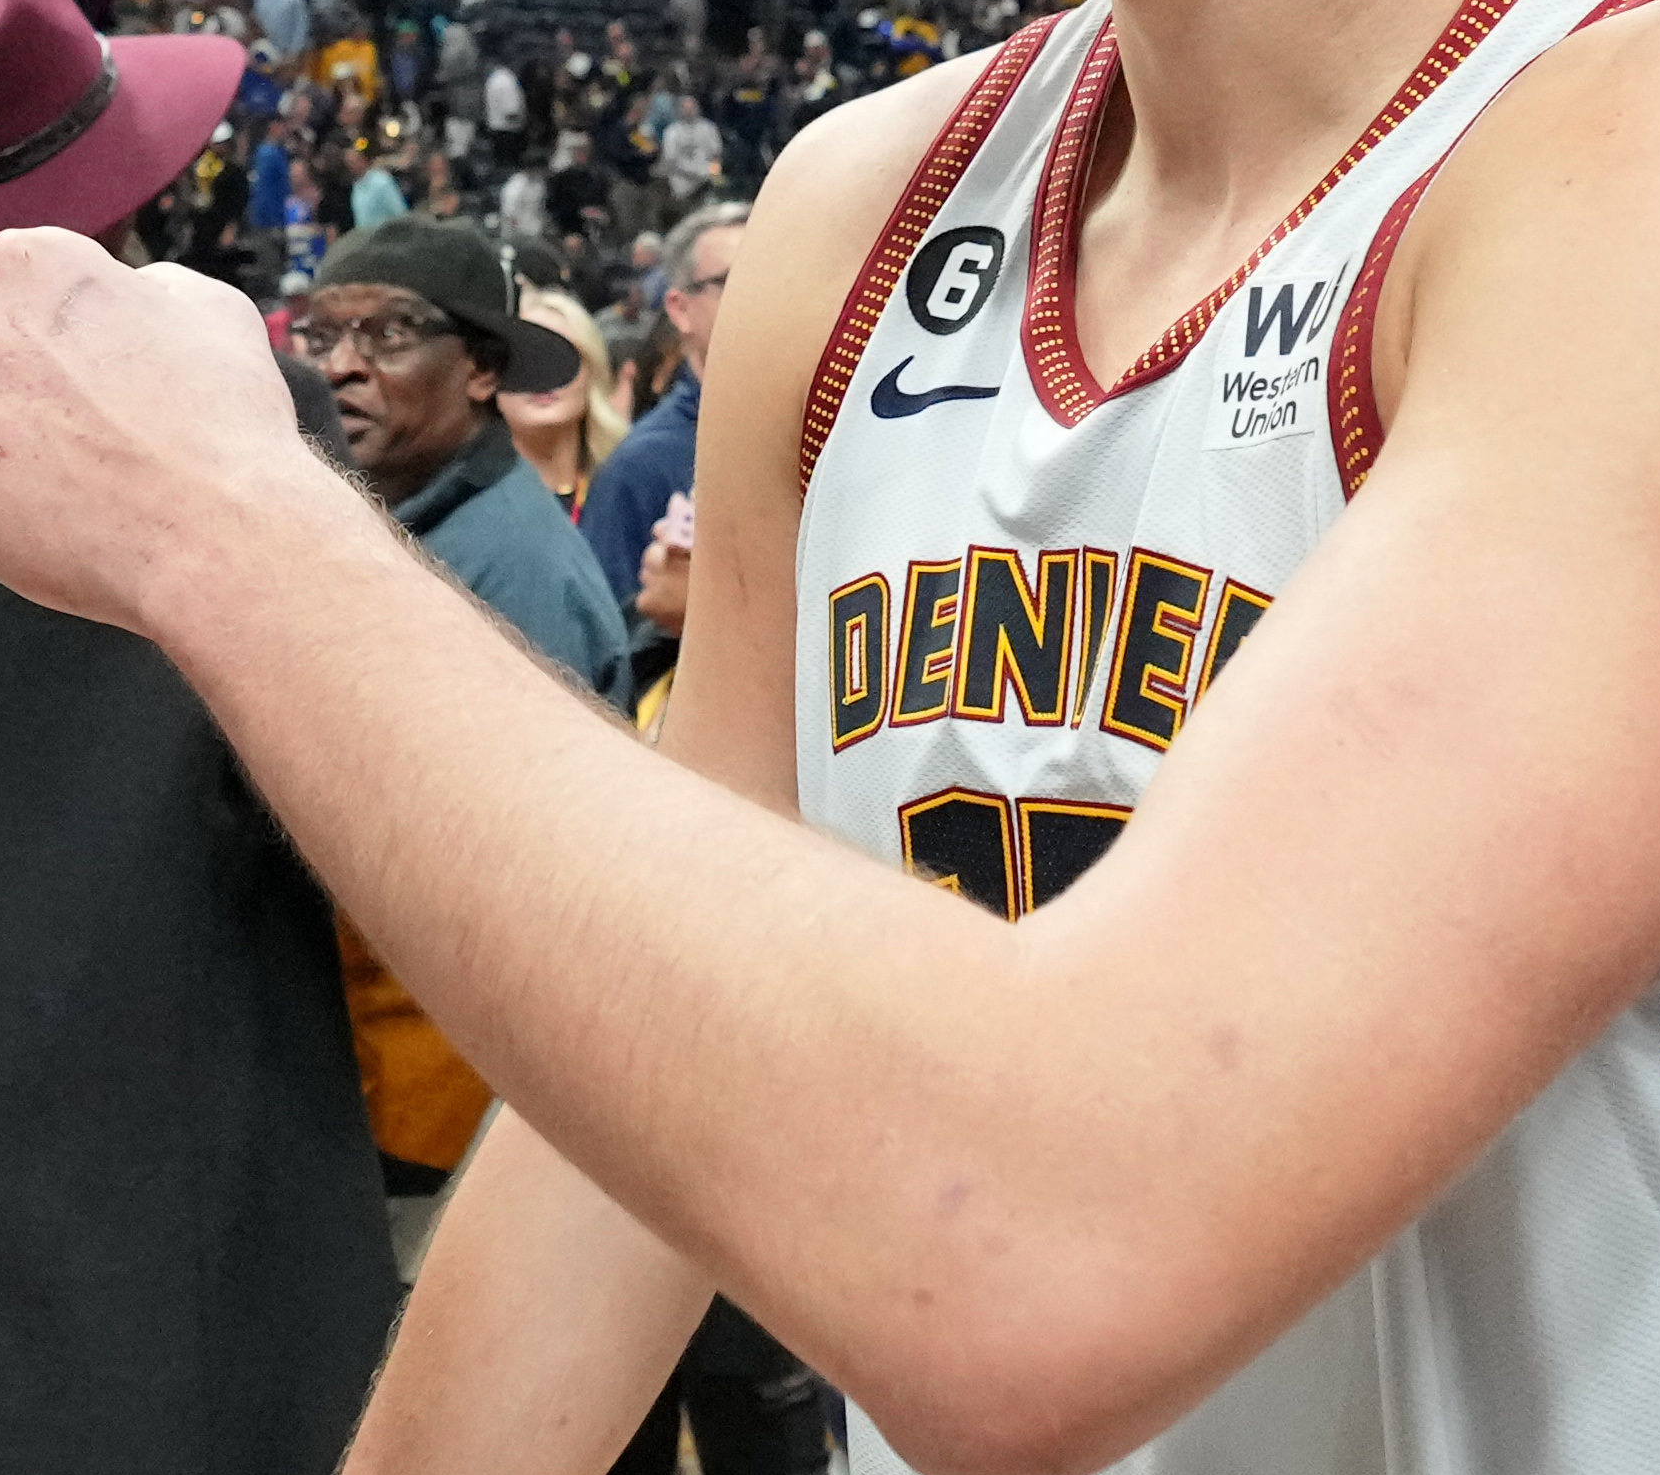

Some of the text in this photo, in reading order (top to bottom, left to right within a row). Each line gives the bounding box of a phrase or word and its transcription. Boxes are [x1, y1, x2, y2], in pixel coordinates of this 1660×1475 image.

[927, 242, 995, 320] 6
[1222, 352, 1320, 405] Western
[1230, 399, 1298, 441] Union
